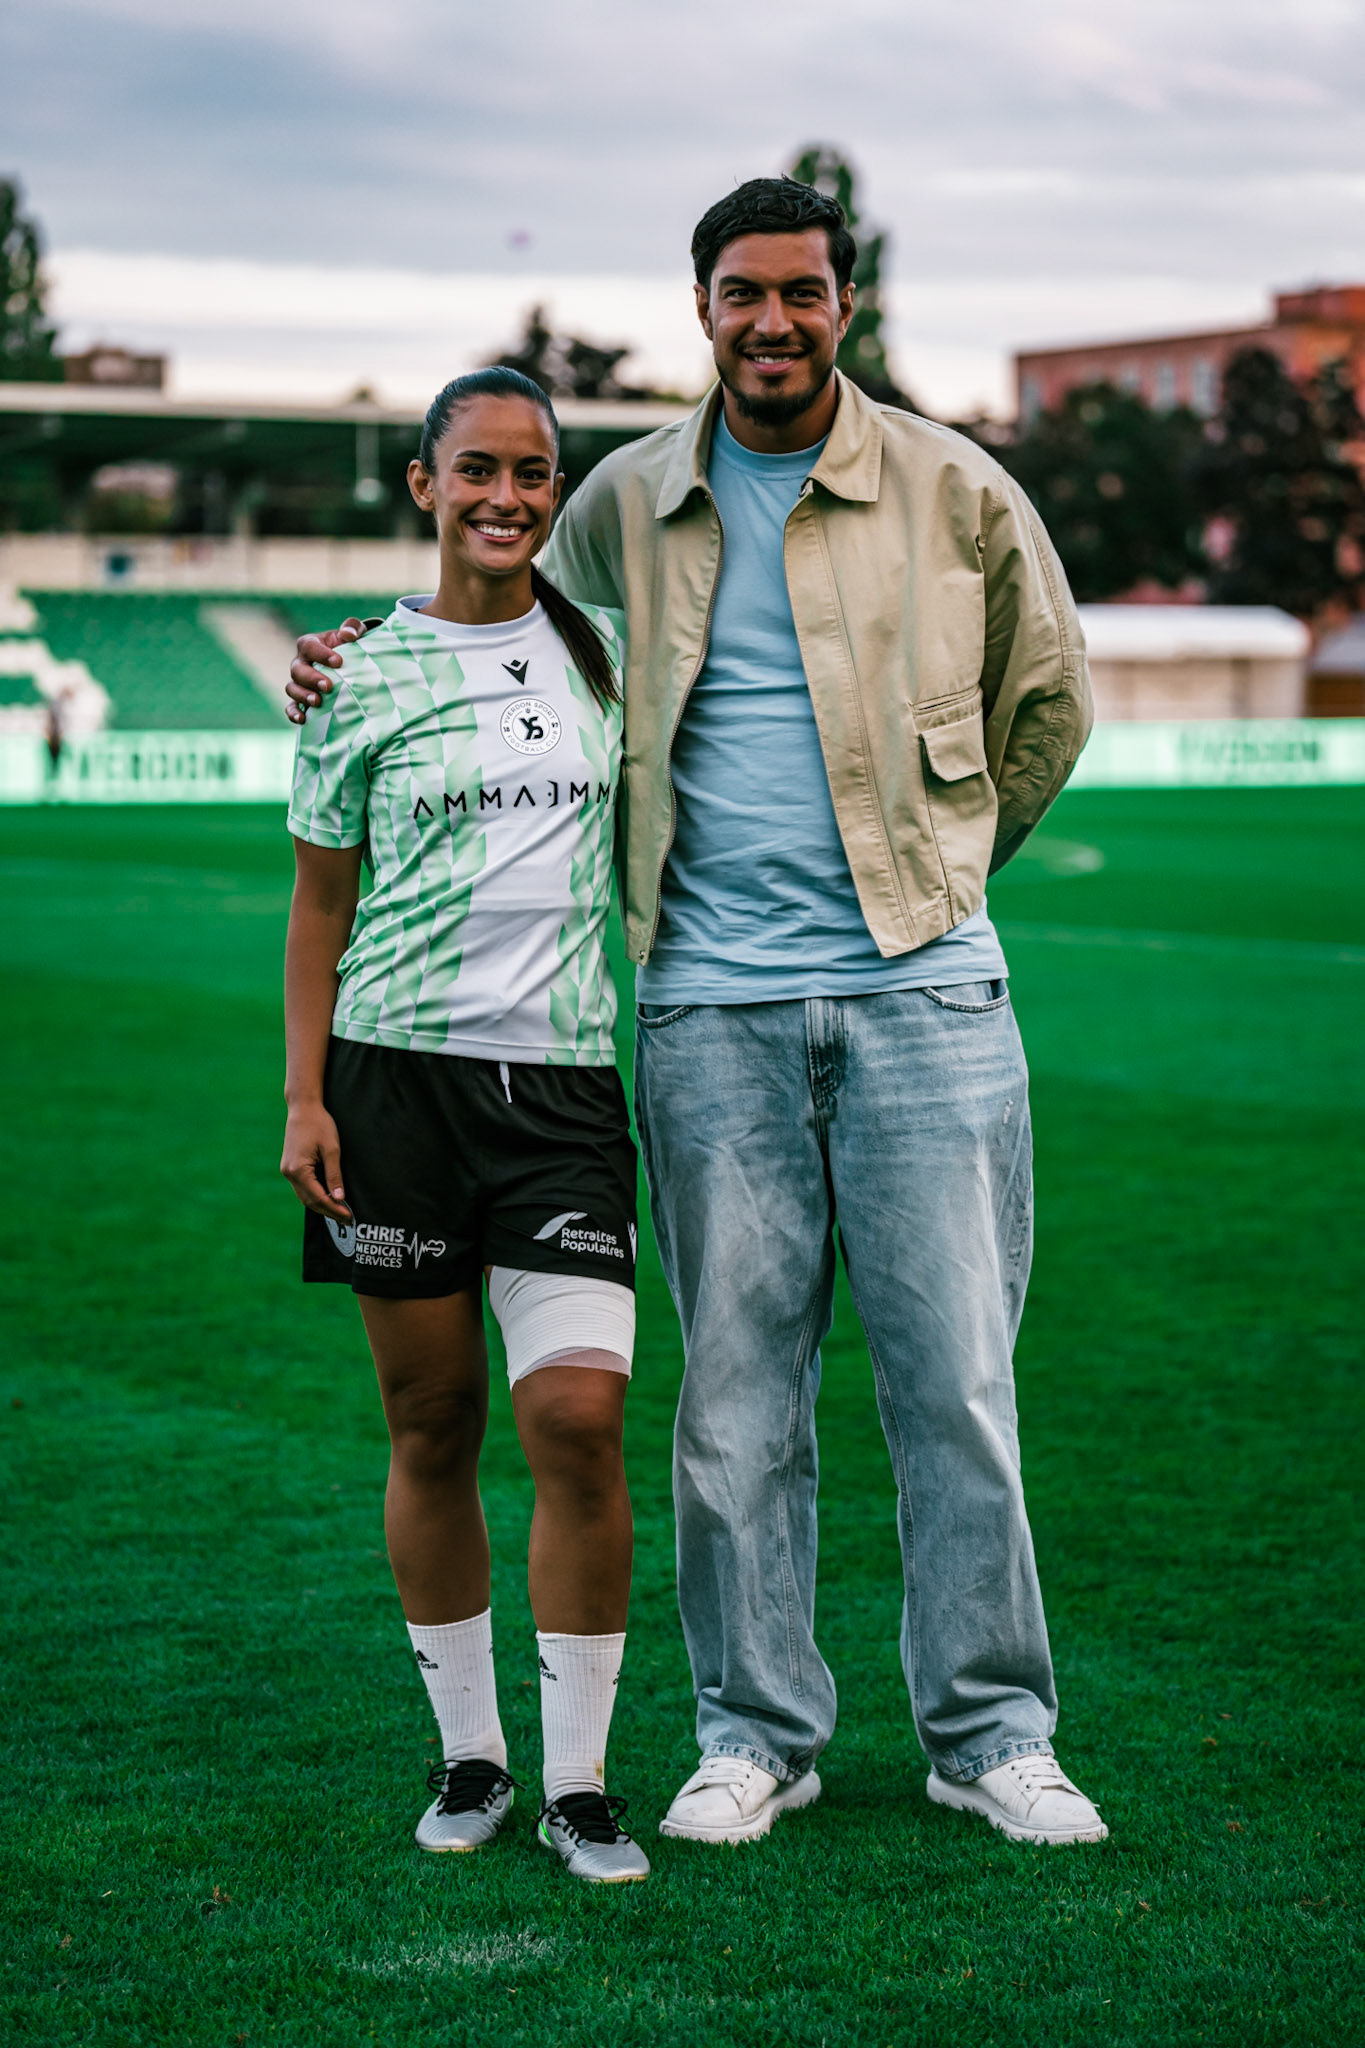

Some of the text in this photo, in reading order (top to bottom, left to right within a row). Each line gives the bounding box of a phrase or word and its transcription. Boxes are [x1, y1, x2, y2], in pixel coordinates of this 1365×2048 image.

[504, 701, 556, 723] YVERDON SPORT
[507, 735, 544, 752] FOOTBALL
[356, 1223, 405, 1243] CHRIS
[561, 1227, 617, 1245] Retraites
[356, 1242, 403, 1258] MEDICAL
[560, 1238, 624, 1259] Populaires
[355, 1253, 402, 1268] SERVICES
